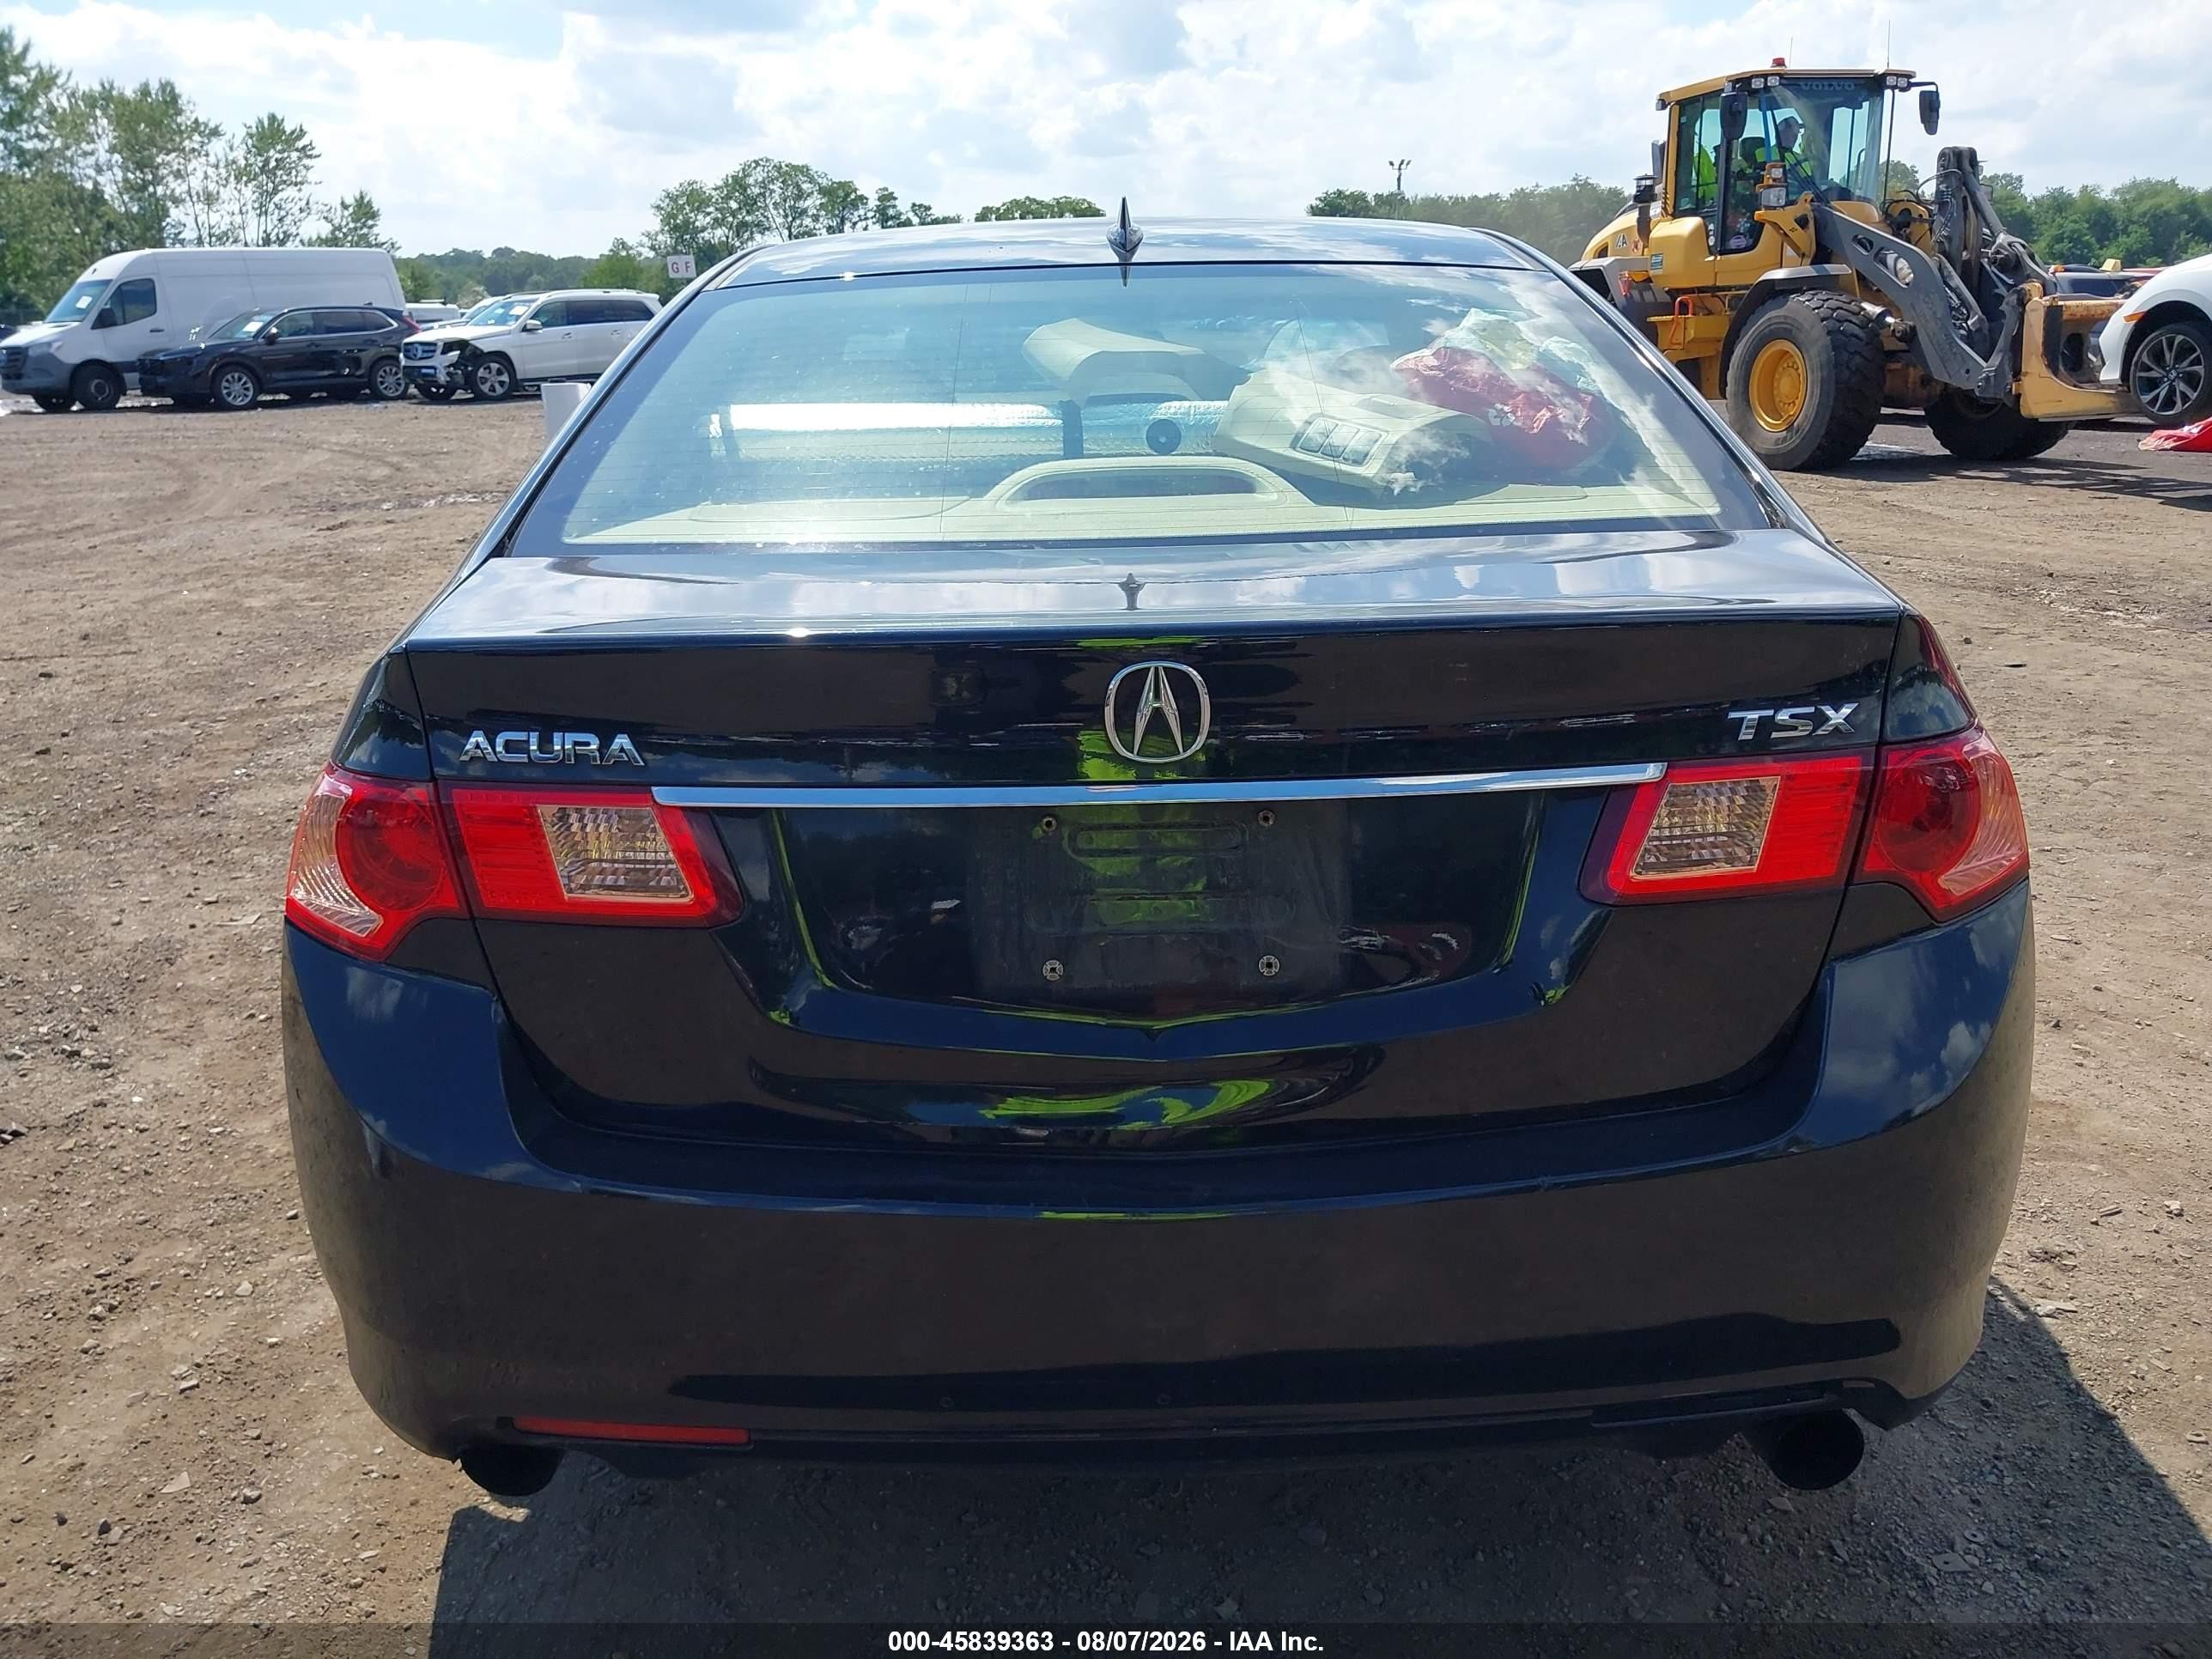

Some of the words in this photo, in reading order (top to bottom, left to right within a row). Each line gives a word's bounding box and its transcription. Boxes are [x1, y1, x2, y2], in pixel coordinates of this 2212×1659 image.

[1799, 82, 1855, 91] VOLVO
[1728, 702, 1859, 741] TSX
[459, 730, 645, 766] ACURA
